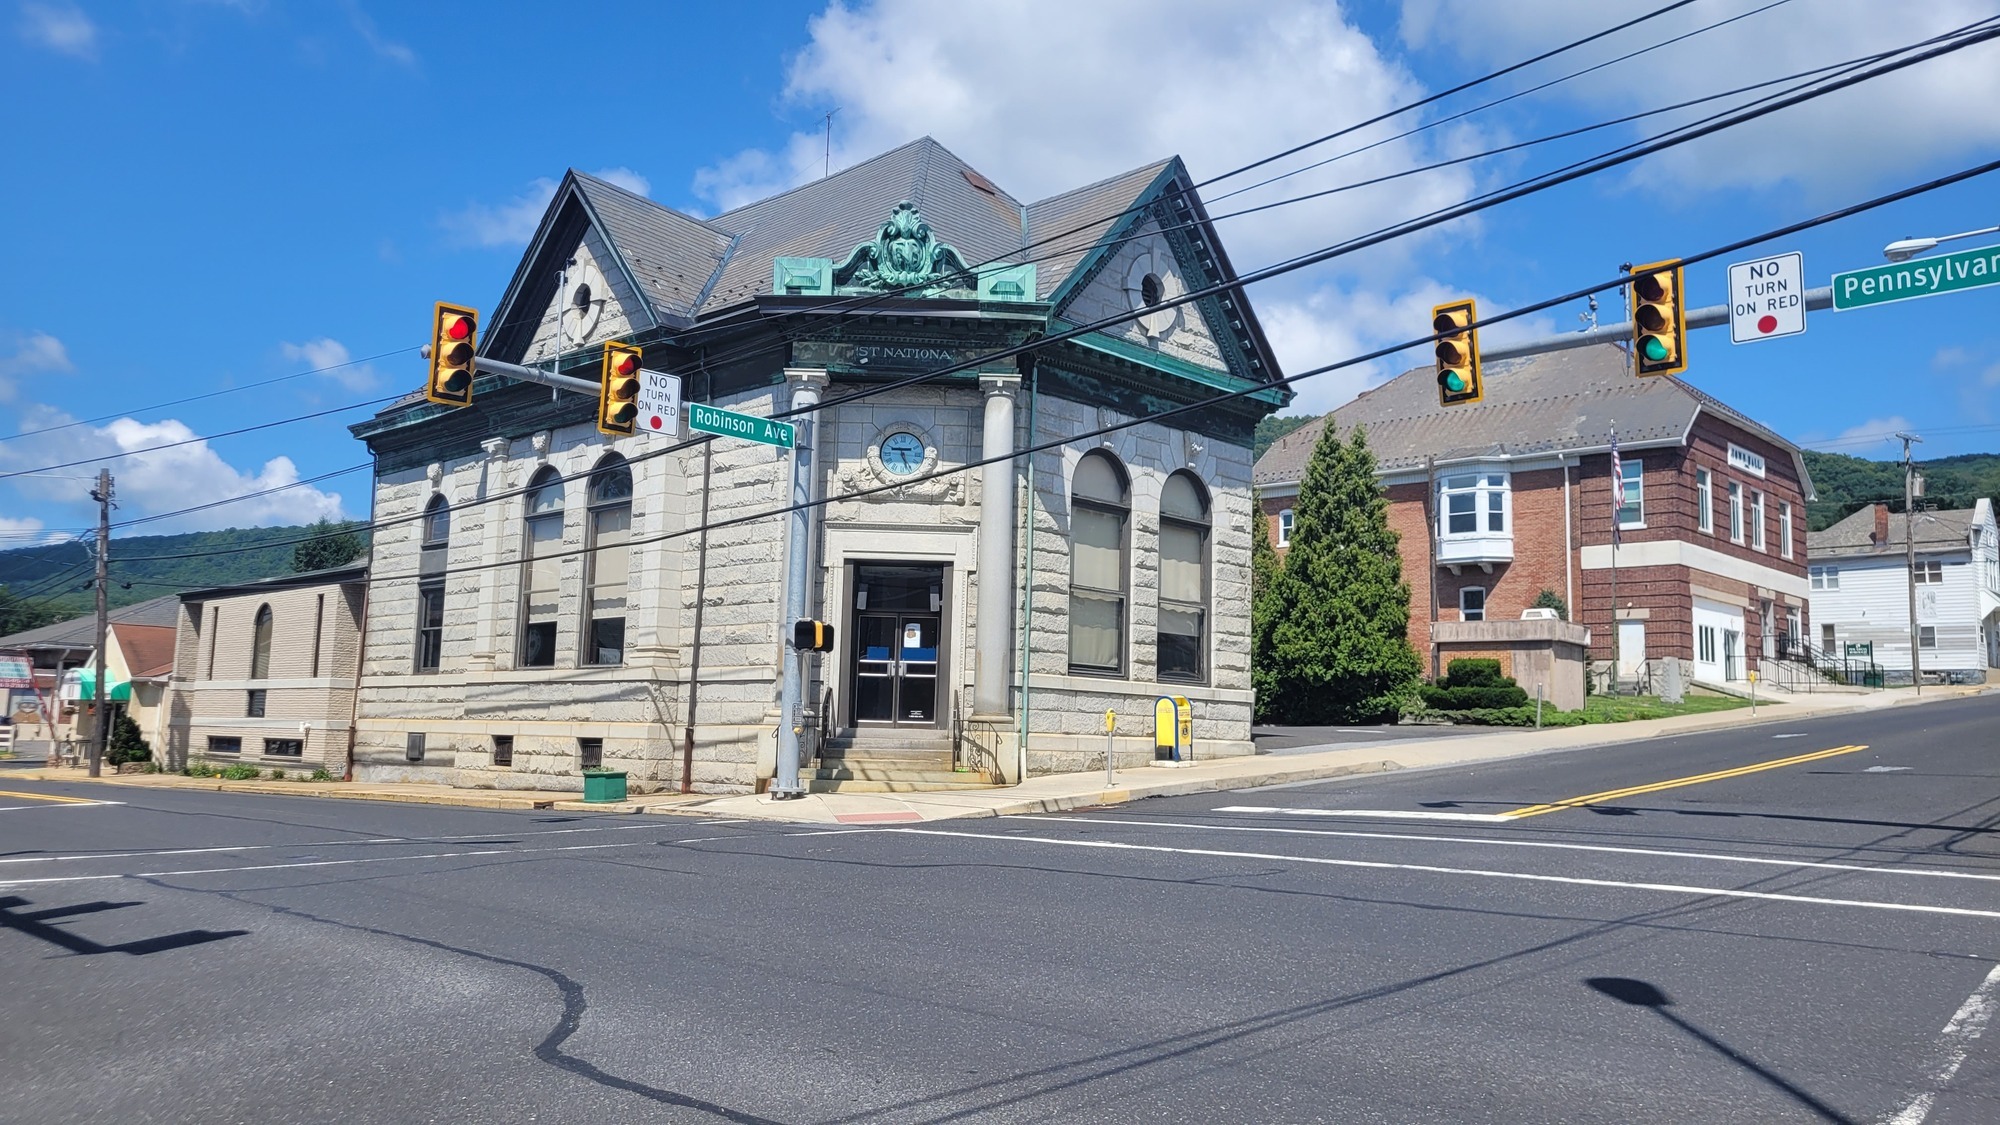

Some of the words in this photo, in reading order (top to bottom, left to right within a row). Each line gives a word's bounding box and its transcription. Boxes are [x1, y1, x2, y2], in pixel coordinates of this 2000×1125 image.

[1750, 262, 1780, 281] NO
[1745, 279, 1788, 298] TURN
[1736, 303, 1757, 317] ON
[1767, 294, 1799, 311] RED
[650, 375, 667, 389] NO
[645, 389, 671, 403] TURN
[638, 400, 651, 412] ON
[657, 405, 676, 417] RED
[696, 408, 754, 435] Robinson
[764, 423, 788, 441] Ave
